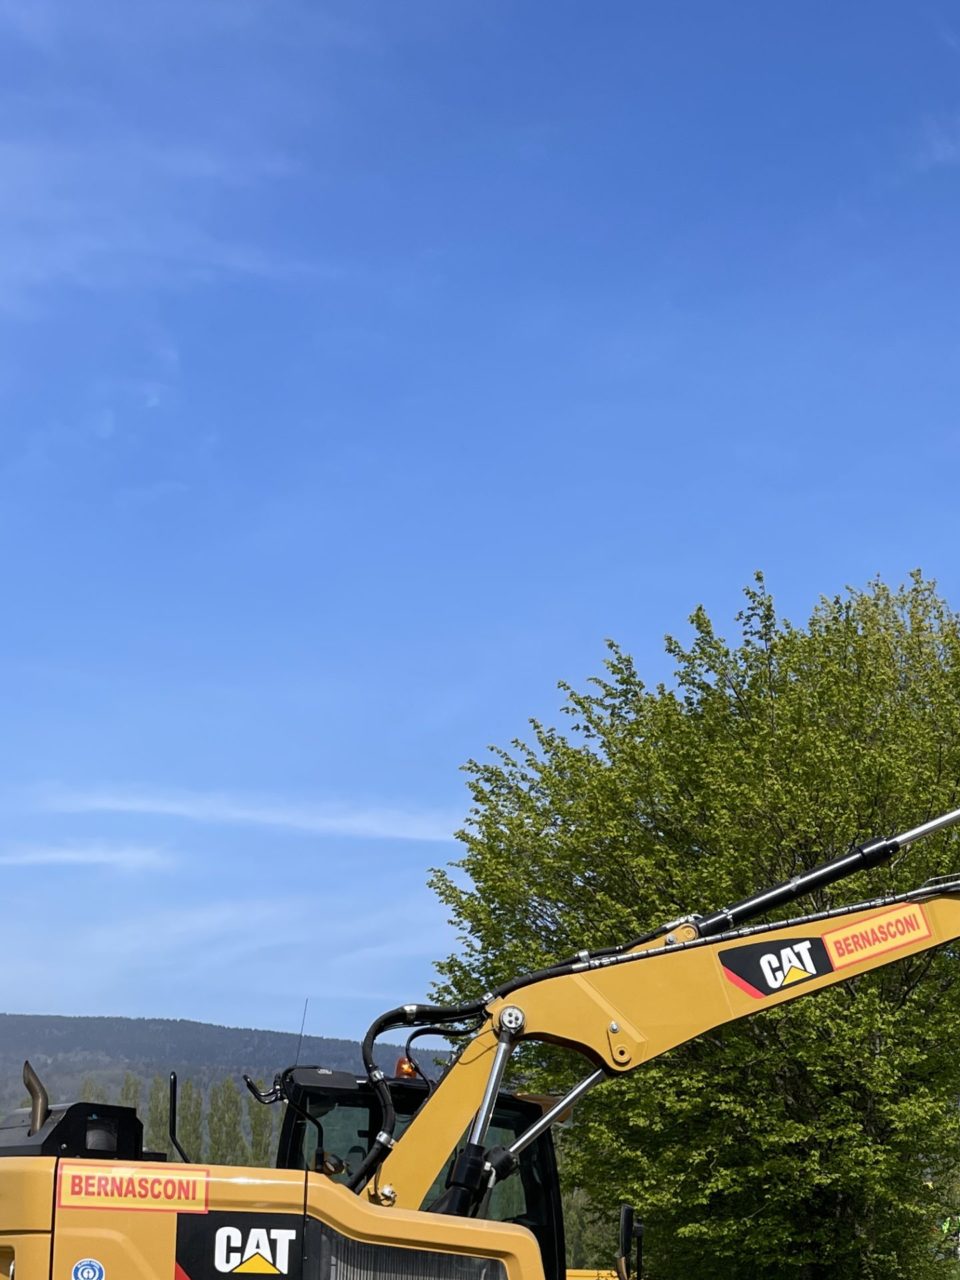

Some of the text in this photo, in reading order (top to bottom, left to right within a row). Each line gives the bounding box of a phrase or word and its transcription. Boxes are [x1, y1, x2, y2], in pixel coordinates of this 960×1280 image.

[833, 914, 921, 958] BERNASCONI
[759, 940, 817, 989] CAT
[70, 1174, 197, 1201] BERNASCONI
[214, 1226, 296, 1275] CAT
